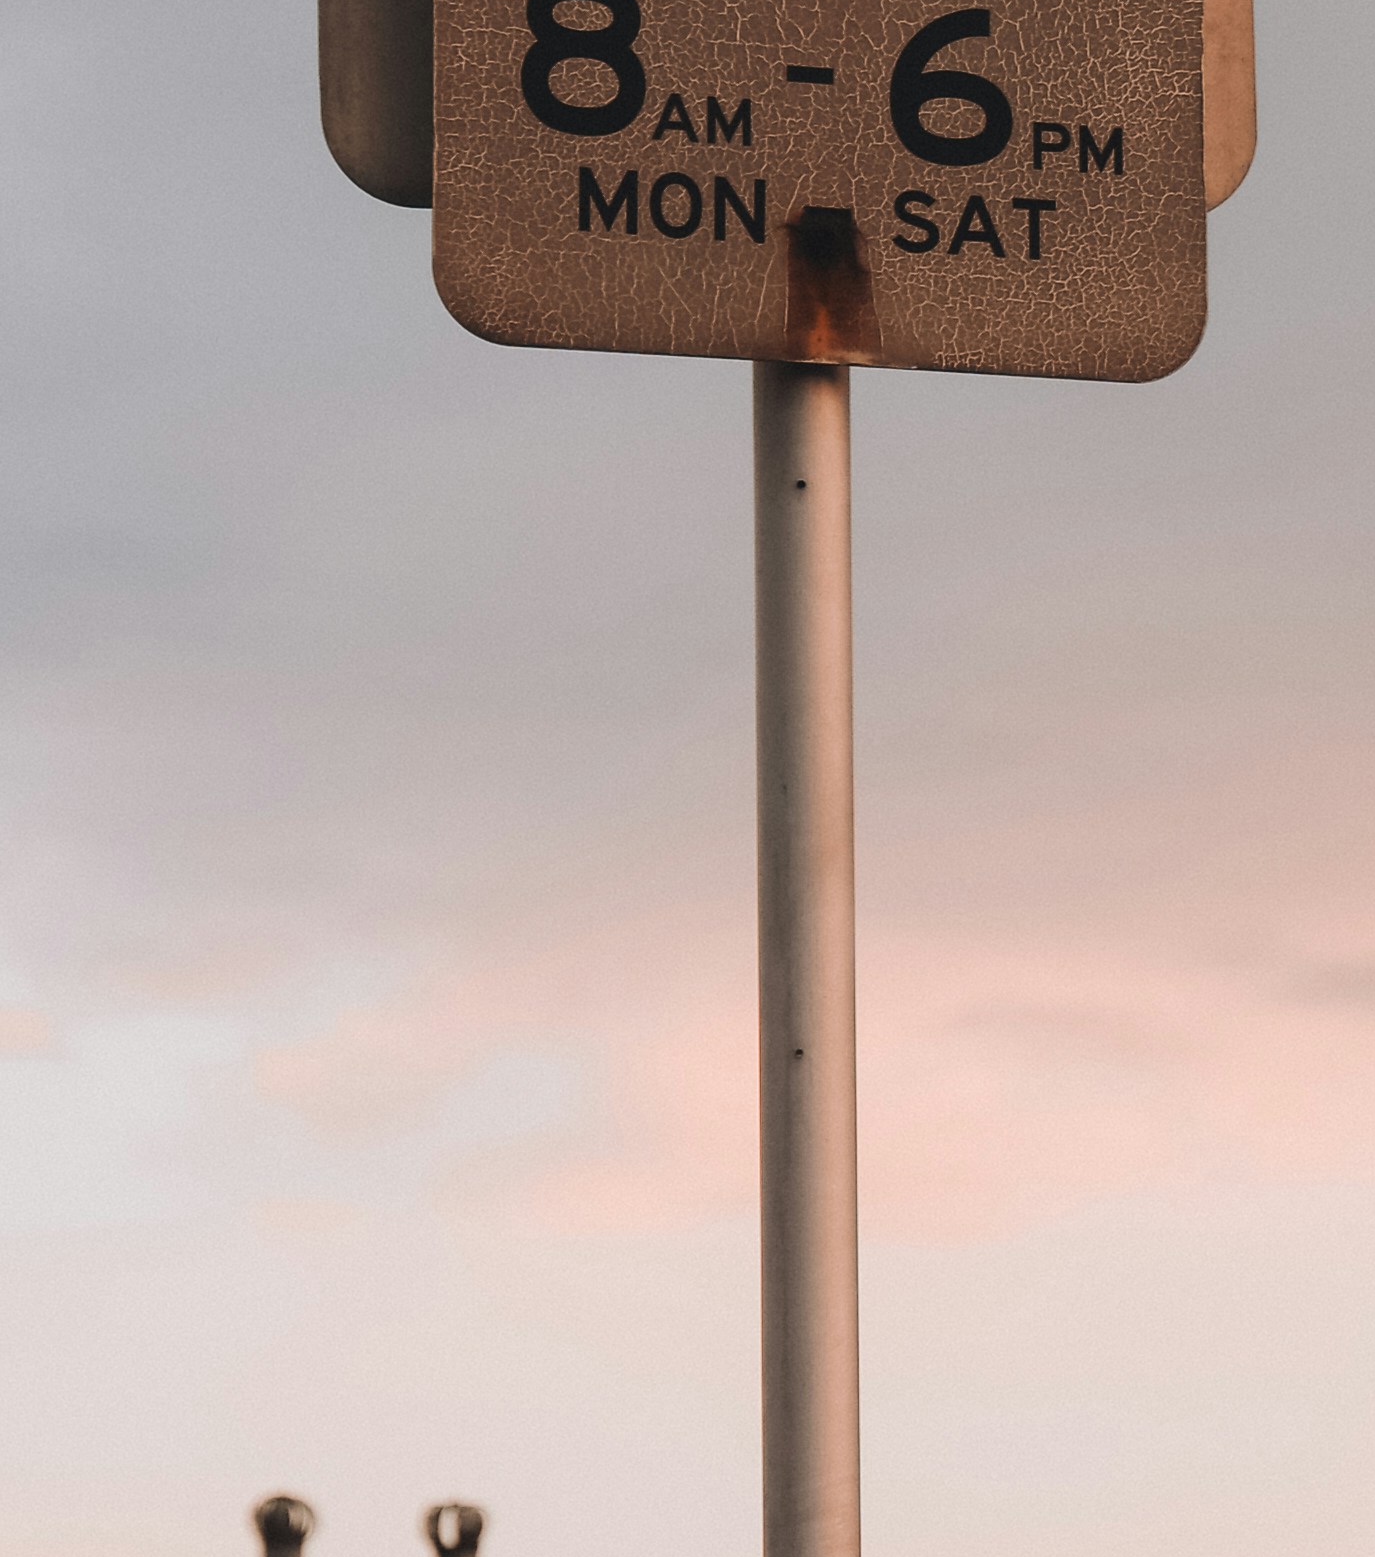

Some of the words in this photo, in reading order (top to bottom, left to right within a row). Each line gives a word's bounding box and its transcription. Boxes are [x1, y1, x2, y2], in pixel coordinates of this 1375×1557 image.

[786, 65, 835, 85] -
[577, 166, 767, 244] MON
[892, 190, 1057, 260] SAT
